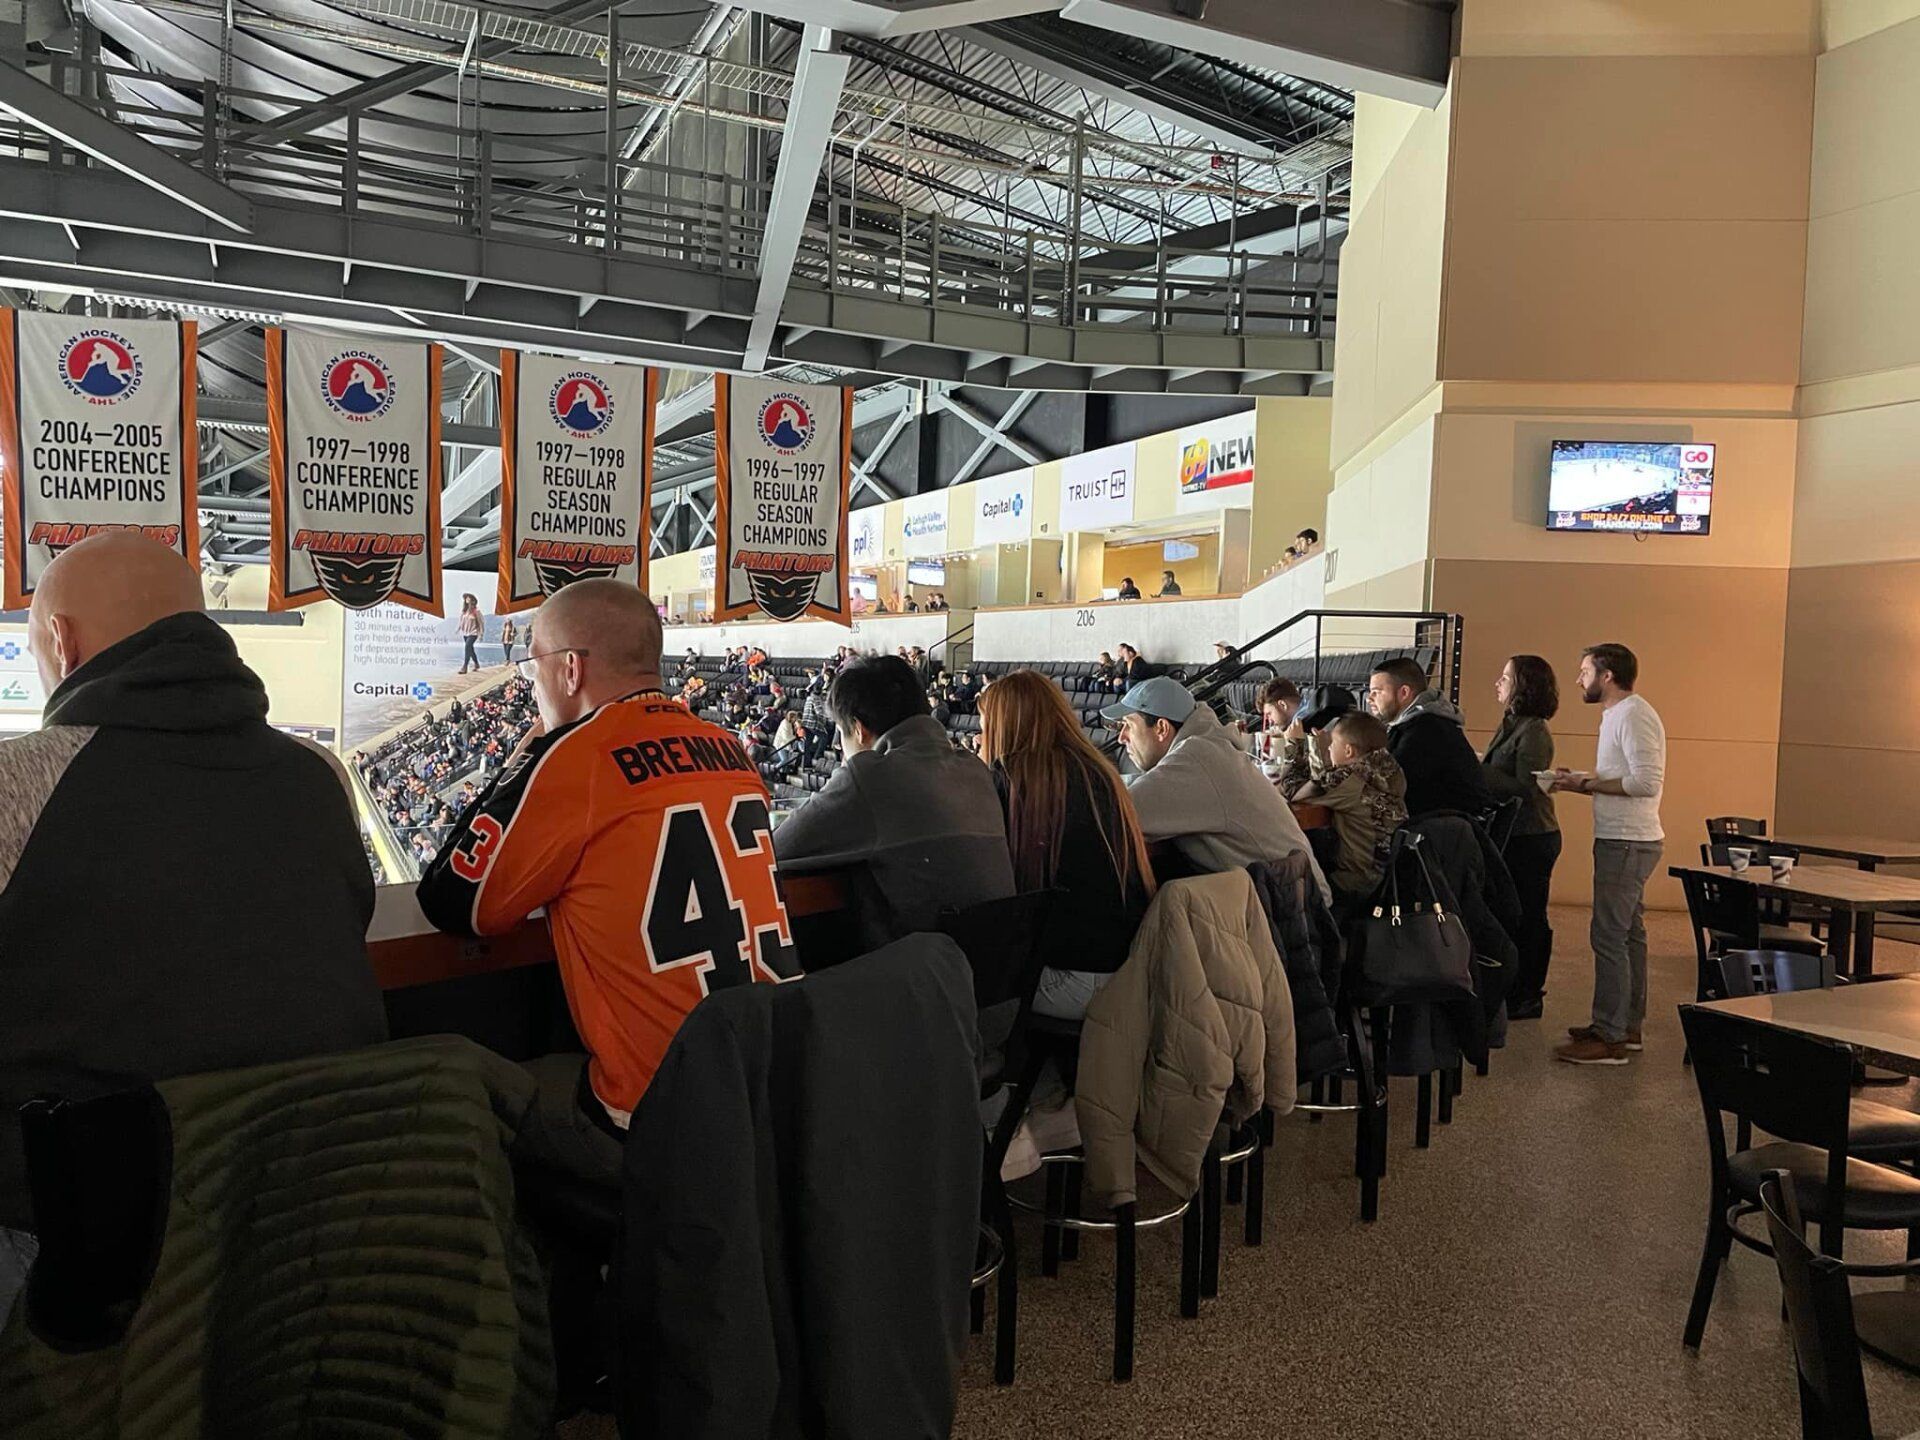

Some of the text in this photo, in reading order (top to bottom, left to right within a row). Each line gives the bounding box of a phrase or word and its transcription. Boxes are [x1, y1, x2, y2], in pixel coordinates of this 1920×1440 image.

[57, 329, 143, 400] AMERICAN HOCKEY LEAGUE
[321, 351, 396, 417] AMERICAN HOCKEY LEAGUE
[88, 397, 117, 405] AHL
[549, 371, 614, 435] AMERICAN HOCKEY LEAGUE
[346, 414, 372, 422] AHL
[757, 392, 816, 450] AMERICAN HOCKEY LEAGUE
[570, 431, 592, 439] AHL
[33, 447, 171, 475] CONFERENCE
[777, 448, 796, 456] AHL
[1685, 451, 1709, 463] GO
[297, 462, 419, 490] CONFERENCE
[543, 465, 617, 491] REGULAR
[40, 475, 166, 502] CHAMPIONS
[753, 481, 818, 503] REGULAR
[1068, 479, 1108, 502] TRUIST
[303, 488, 414, 515] CHAMPIONS
[547, 489, 611, 514] SEASON
[982, 497, 1011, 518] Capital
[531, 511, 626, 538] CHAMPIONS
[757, 503, 813, 525] SEASON
[1581, 512, 1606, 521] SHOP
[1606, 513, 1629, 522] 24/7
[1630, 514, 1663, 523] ONLINE
[1663, 514, 1676, 524] AT
[28, 521, 181, 547] PHAMS
[291, 529, 425, 555] PHANTOMS
[743, 525, 827, 547] CHAMPIONS
[853, 529, 867, 556] ppl
[517, 538, 637, 565] PHANTOMS
[732, 549, 835, 573] PHANTOMS
[386, 609, 424, 621] nature
[1076, 609, 1096, 627] 206
[354, 621, 436, 634] 30 minutes a week
[372, 632, 391, 644] help
[393, 633, 432, 645] decrease
[434, 635, 448, 645] risk
[353, 654, 437, 667] high blood pressure
[354, 643, 430, 656] of depression and
[353, 682, 409, 698] Capital
[611, 736, 757, 785] BRENNAN
[450, 813, 504, 882] 3
[641, 793, 806, 998] 43
